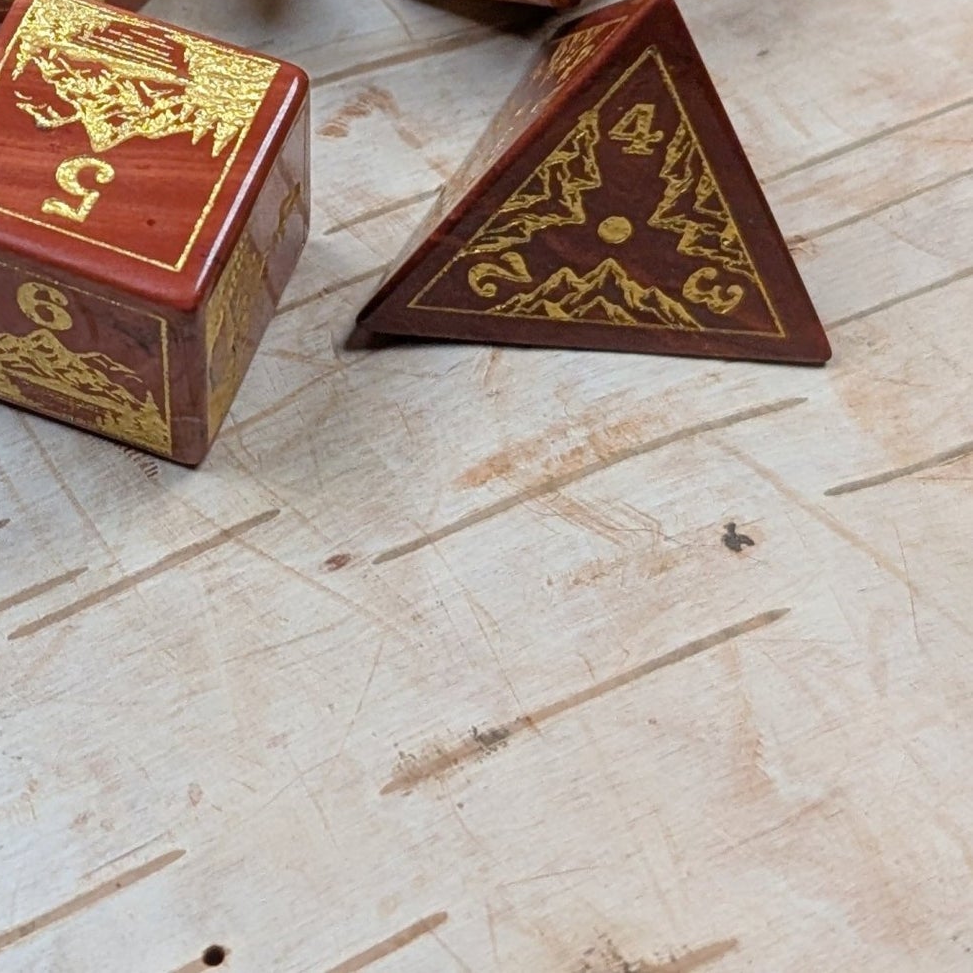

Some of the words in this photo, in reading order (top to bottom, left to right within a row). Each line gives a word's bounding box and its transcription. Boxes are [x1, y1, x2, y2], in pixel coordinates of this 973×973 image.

[608, 103, 664, 155] 4
[40, 154, 115, 223] 5
[467, 251, 534, 298] 2
[682, 267, 745, 314] 3
[16, 281, 74, 331] 6
